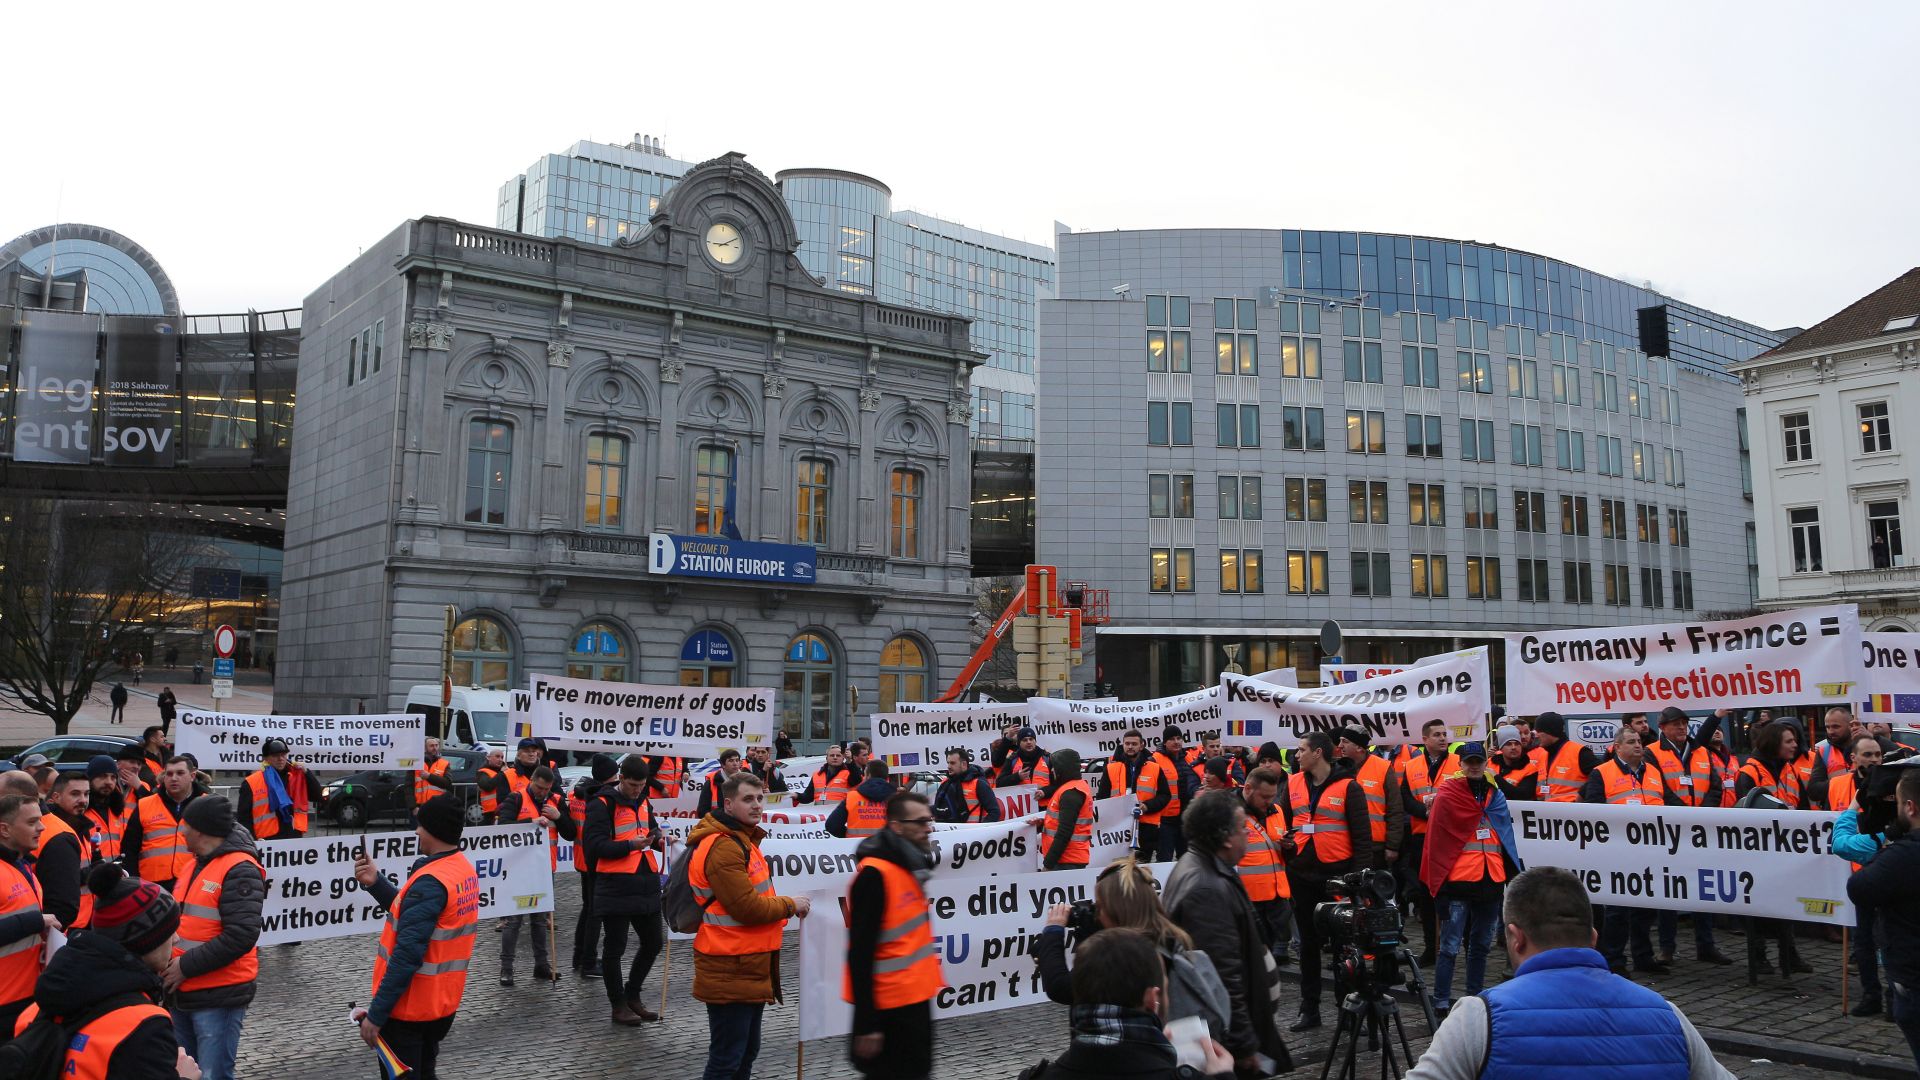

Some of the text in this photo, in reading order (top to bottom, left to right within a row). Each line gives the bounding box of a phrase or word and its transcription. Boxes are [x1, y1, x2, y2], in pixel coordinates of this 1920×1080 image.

[110, 381, 169, 390] 2018 Sakharov
[680, 541, 729, 555] WELCOME TO
[680, 554, 785, 577] STATION EUROPE
[710, 641, 728, 649] Station
[710, 648, 729, 656] Europe
[1520, 616, 1840, 666] Germany + France =
[536, 681, 767, 715] Free movement of goods
[1227, 671, 1472, 708] Keep Europe one
[1555, 664, 1802, 710] neoprotectionism
[1069, 703, 1090, 713] We
[1094, 703, 1144, 714] believe
[1148, 701, 1161, 712] in
[1165, 701, 1173, 709] a
[1177, 693, 1204, 705] free
[182, 713, 421, 730] Continue the FREE movement
[559, 712, 574, 732] is
[581, 717, 617, 734] one
[624, 716, 644, 735] of
[649, 717, 676, 736] EU
[682, 718, 745, 739] bases!
[878, 718, 910, 738] One
[916, 716, 973, 735] market
[1035, 705, 1221, 736] with less and less protecti
[210, 733, 226, 745] of
[233, 732, 260, 745] the
[319, 735, 333, 746] in
[338, 735, 363, 746] the
[369, 734, 394, 749] EU,
[219, 750, 264, 763] witho
[288, 750, 384, 765] restrictions!
[925, 747, 940, 765] Is
[458, 827, 543, 851] ovement
[1096, 829, 1132, 846] laws
[1521, 811, 1834, 855] Europe only a market?
[259, 846, 319, 869] tinue
[327, 842, 363, 863] the
[764, 853, 857, 877] movem
[951, 831, 1026, 869] goods
[475, 858, 508, 881] EU,
[282, 877, 322, 899] the
[1611, 866, 1655, 897] not
[1664, 866, 1688, 900] in
[1697, 868, 1754, 904] EU?
[967, 883, 1018, 917] did
[1029, 885, 1086, 919] you
[261, 903, 355, 932] without
